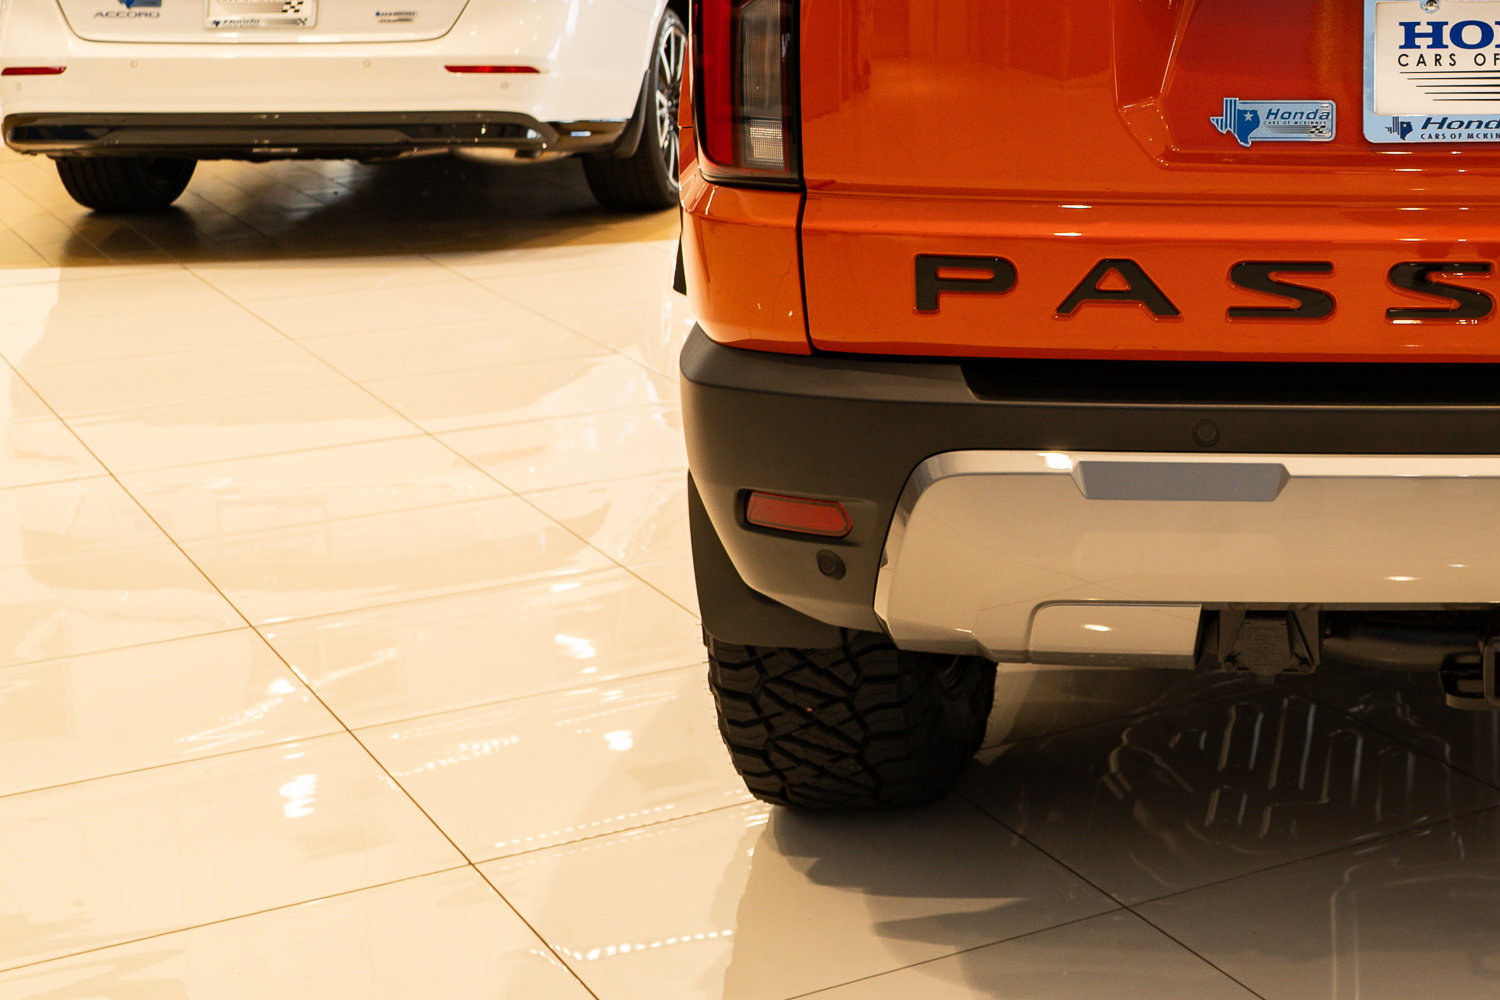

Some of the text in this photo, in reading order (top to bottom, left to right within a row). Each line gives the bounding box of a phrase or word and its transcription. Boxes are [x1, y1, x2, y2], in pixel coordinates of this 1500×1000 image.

[1397, 53, 1457, 67] CARS
[1473, 53, 1500, 67] OF
[1265, 108, 1331, 120] Honda
[1420, 132, 1446, 140] CARS
[1450, 132, 1463, 140] OF
